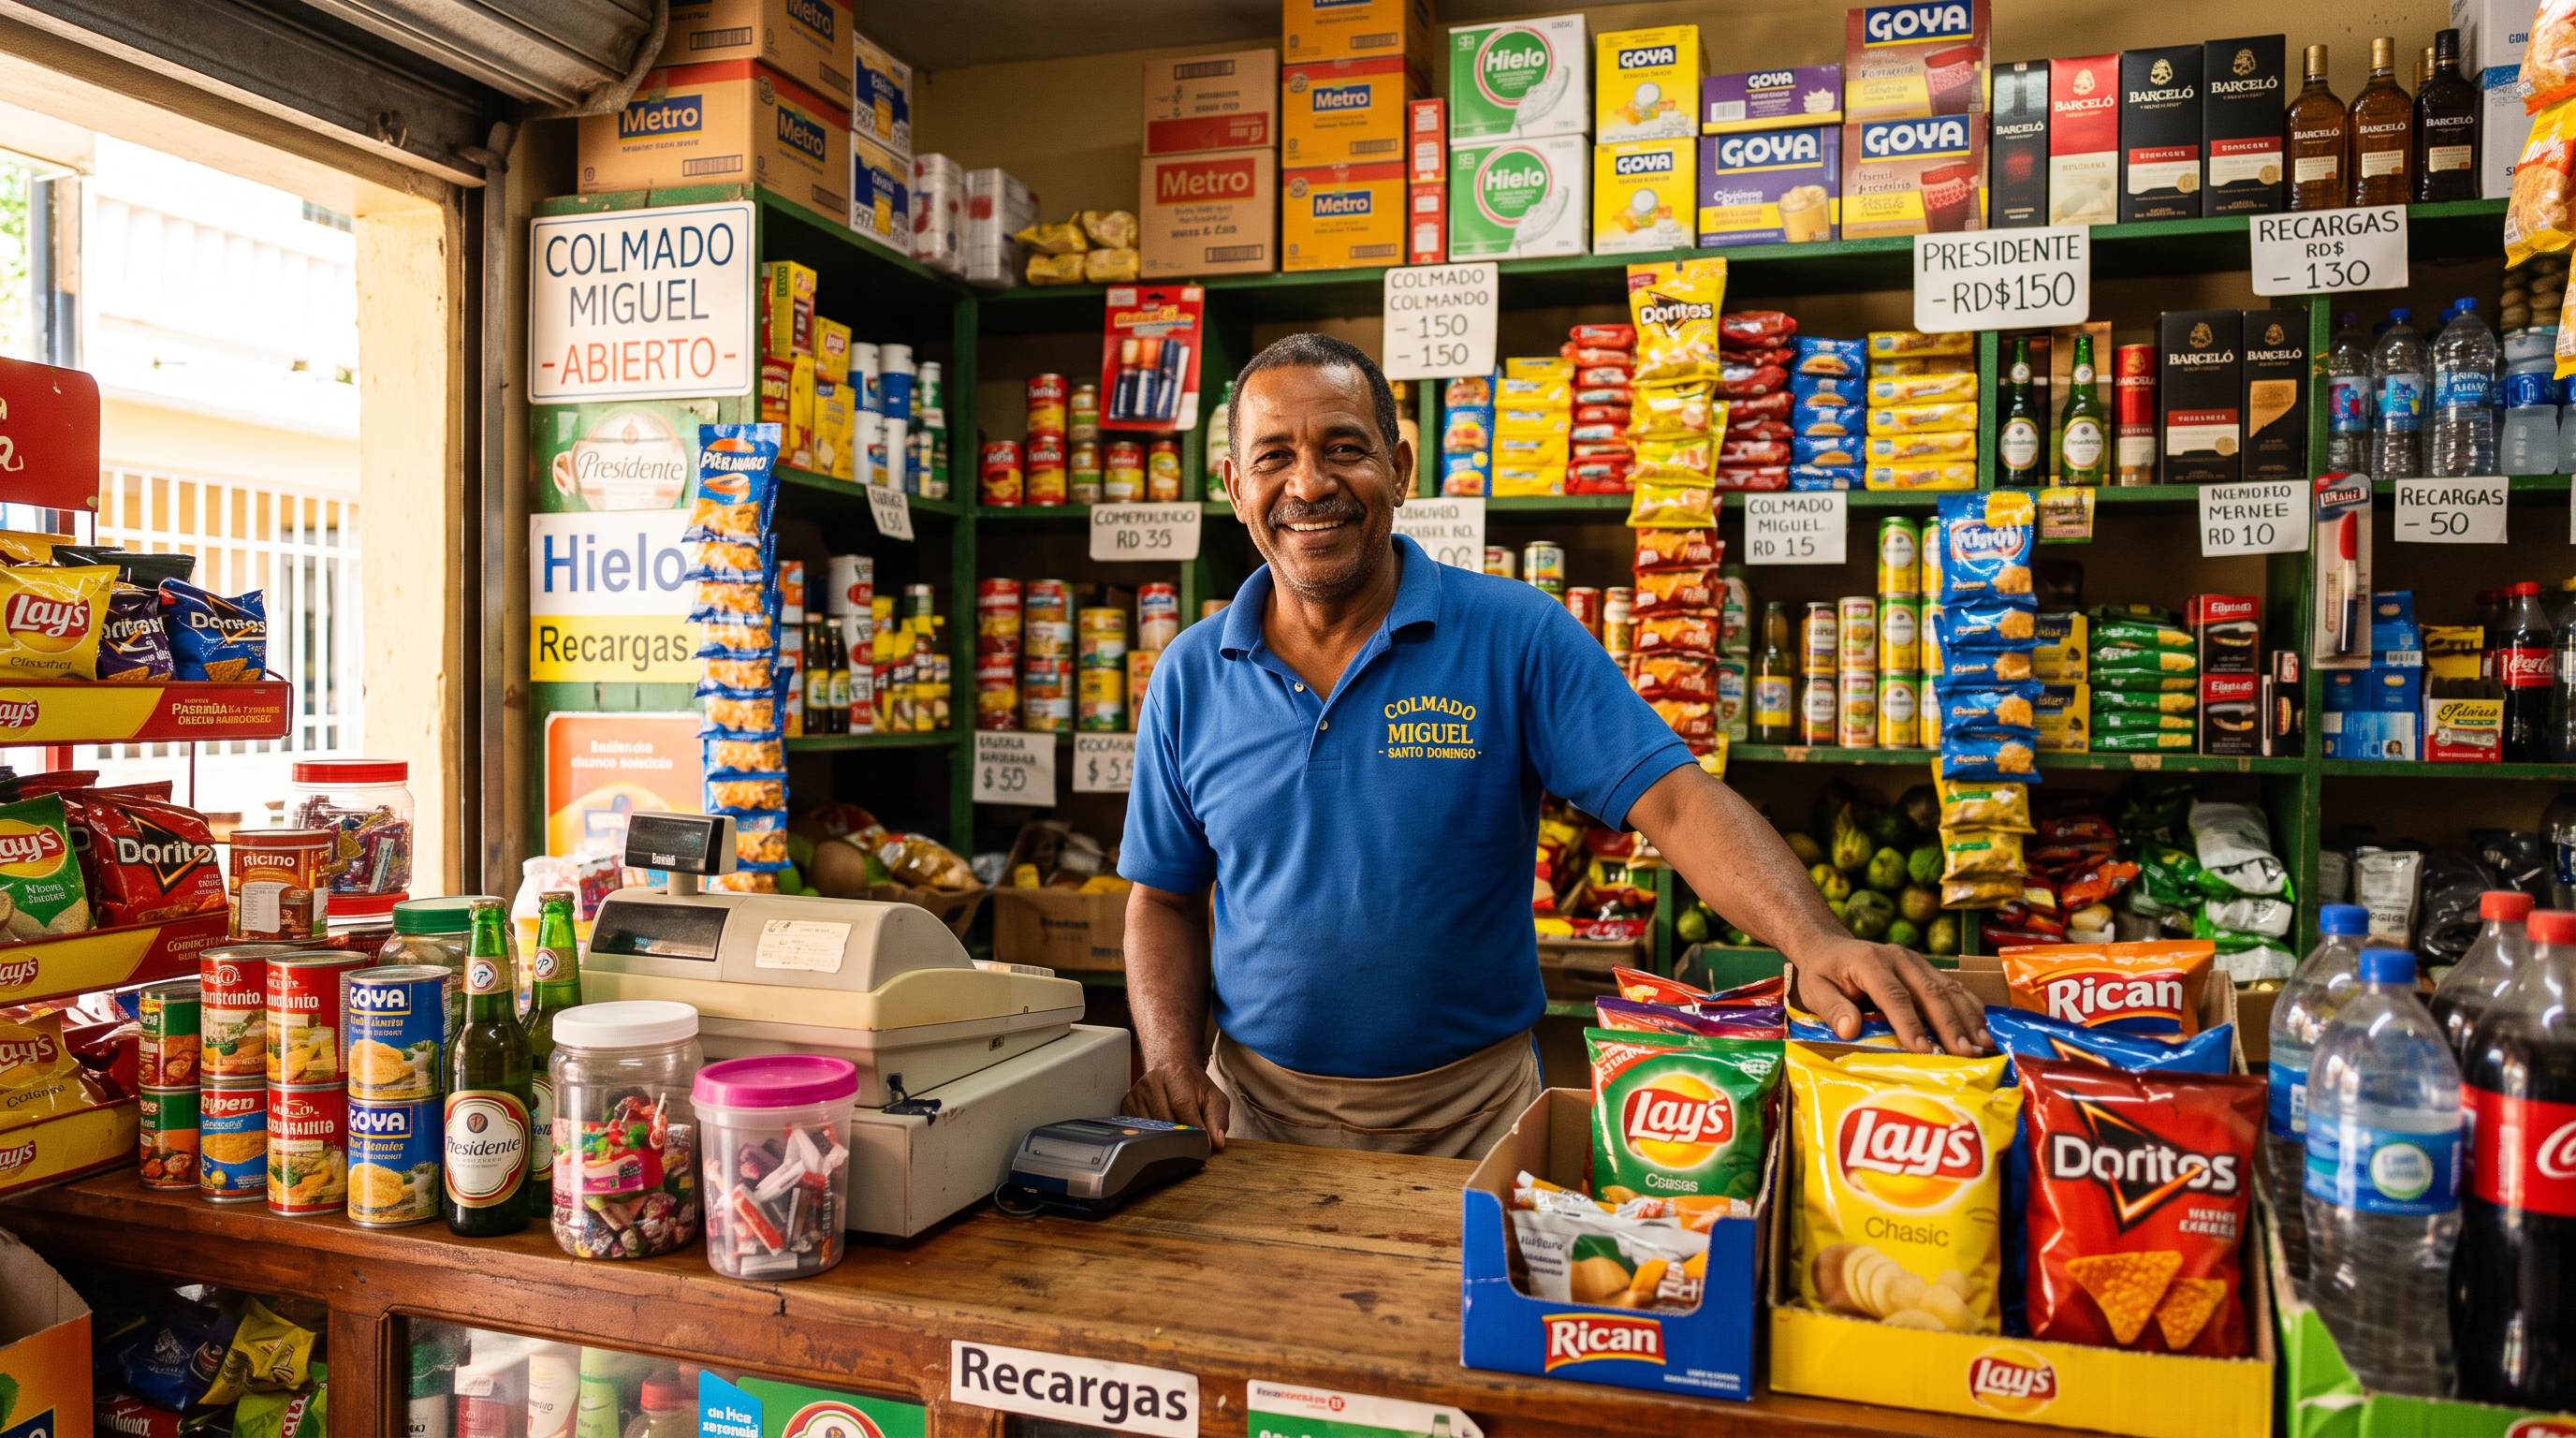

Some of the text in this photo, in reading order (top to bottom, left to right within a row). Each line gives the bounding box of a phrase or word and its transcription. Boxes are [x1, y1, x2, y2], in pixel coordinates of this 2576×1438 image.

[1868, 5, 1968, 41] GOYA
[1486, 48, 1544, 73] Hielo
[1619, 47, 1675, 69] GOYA
[1747, 71, 1793, 89] GOYA
[2211, 74, 2278, 95] BARCELÓ
[1315, 90, 1368, 110] Metro
[2054, 94, 2115, 112] BARCELÓ
[2129, 84, 2195, 104] BARCELÓ
[623, 106, 699, 134] Metro
[1996, 120, 2044, 136] BARCELÓ
[2426, 114, 2474, 127] BARCELÓ
[779, 112, 825, 156] Metro
[1865, 120, 1964, 155] GOYA
[1720, 133, 1817, 168] GOYA
[1617, 153, 1672, 175] GOYA
[1161, 169, 1251, 198] Metro
[1486, 167, 1544, 192] Hielo
[1315, 197, 1369, 215] Metro
[2259, 210, 2399, 243] RECARGAS
[546, 222, 734, 278] COLMADO
[1923, 234, 2081, 272] PRESIDENTE
[2305, 241, 2345, 258] RD$
[1391, 268, 1486, 290] COLMADO
[2305, 259, 2371, 290] 130
[569, 278, 710, 328] MIGUEL
[1389, 289, 1489, 311] COLMANDO
[1418, 314, 1469, 339] 150
[1639, 301, 1714, 327] Doritos
[1421, 343, 1470, 368] 150
[2168, 348, 2234, 366] BARCELÓ
[578, 450, 683, 480] Presidente
[1749, 498, 1834, 516] COLMADO
[2400, 487, 2504, 506] RECARGAS
[2208, 522, 2276, 547] RD 10
[2429, 511, 2469, 536] 50
[1116, 529, 1140, 550] RD
[1753, 536, 1816, 558] RD 15
[543, 533, 687, 593] Hielo
[539, 624, 688, 672] Recargas
[0, 700, 37, 728] ay's
[1383, 696, 1477, 722] COLMADO
[1387, 723, 1474, 744] MIGUEL
[1387, 746, 1424, 759] SANTO
[349, 988, 406, 1008] GOYA
[2047, 976, 2184, 1024] Rican
[349, 1110, 406, 1132] GOYA
[1629, 1090, 1728, 1143] Lay's
[446, 1136, 521, 1156] Presidente
[1845, 1108, 1975, 1177] Lay's
[2053, 1134, 2238, 1194] Doritos
[1864, 1216, 1949, 1248] Chasic
[1550, 1320, 1658, 1360] Rican
[960, 1346, 1189, 1424] Recargas
[1974, 1358, 2050, 1400] Lay's
